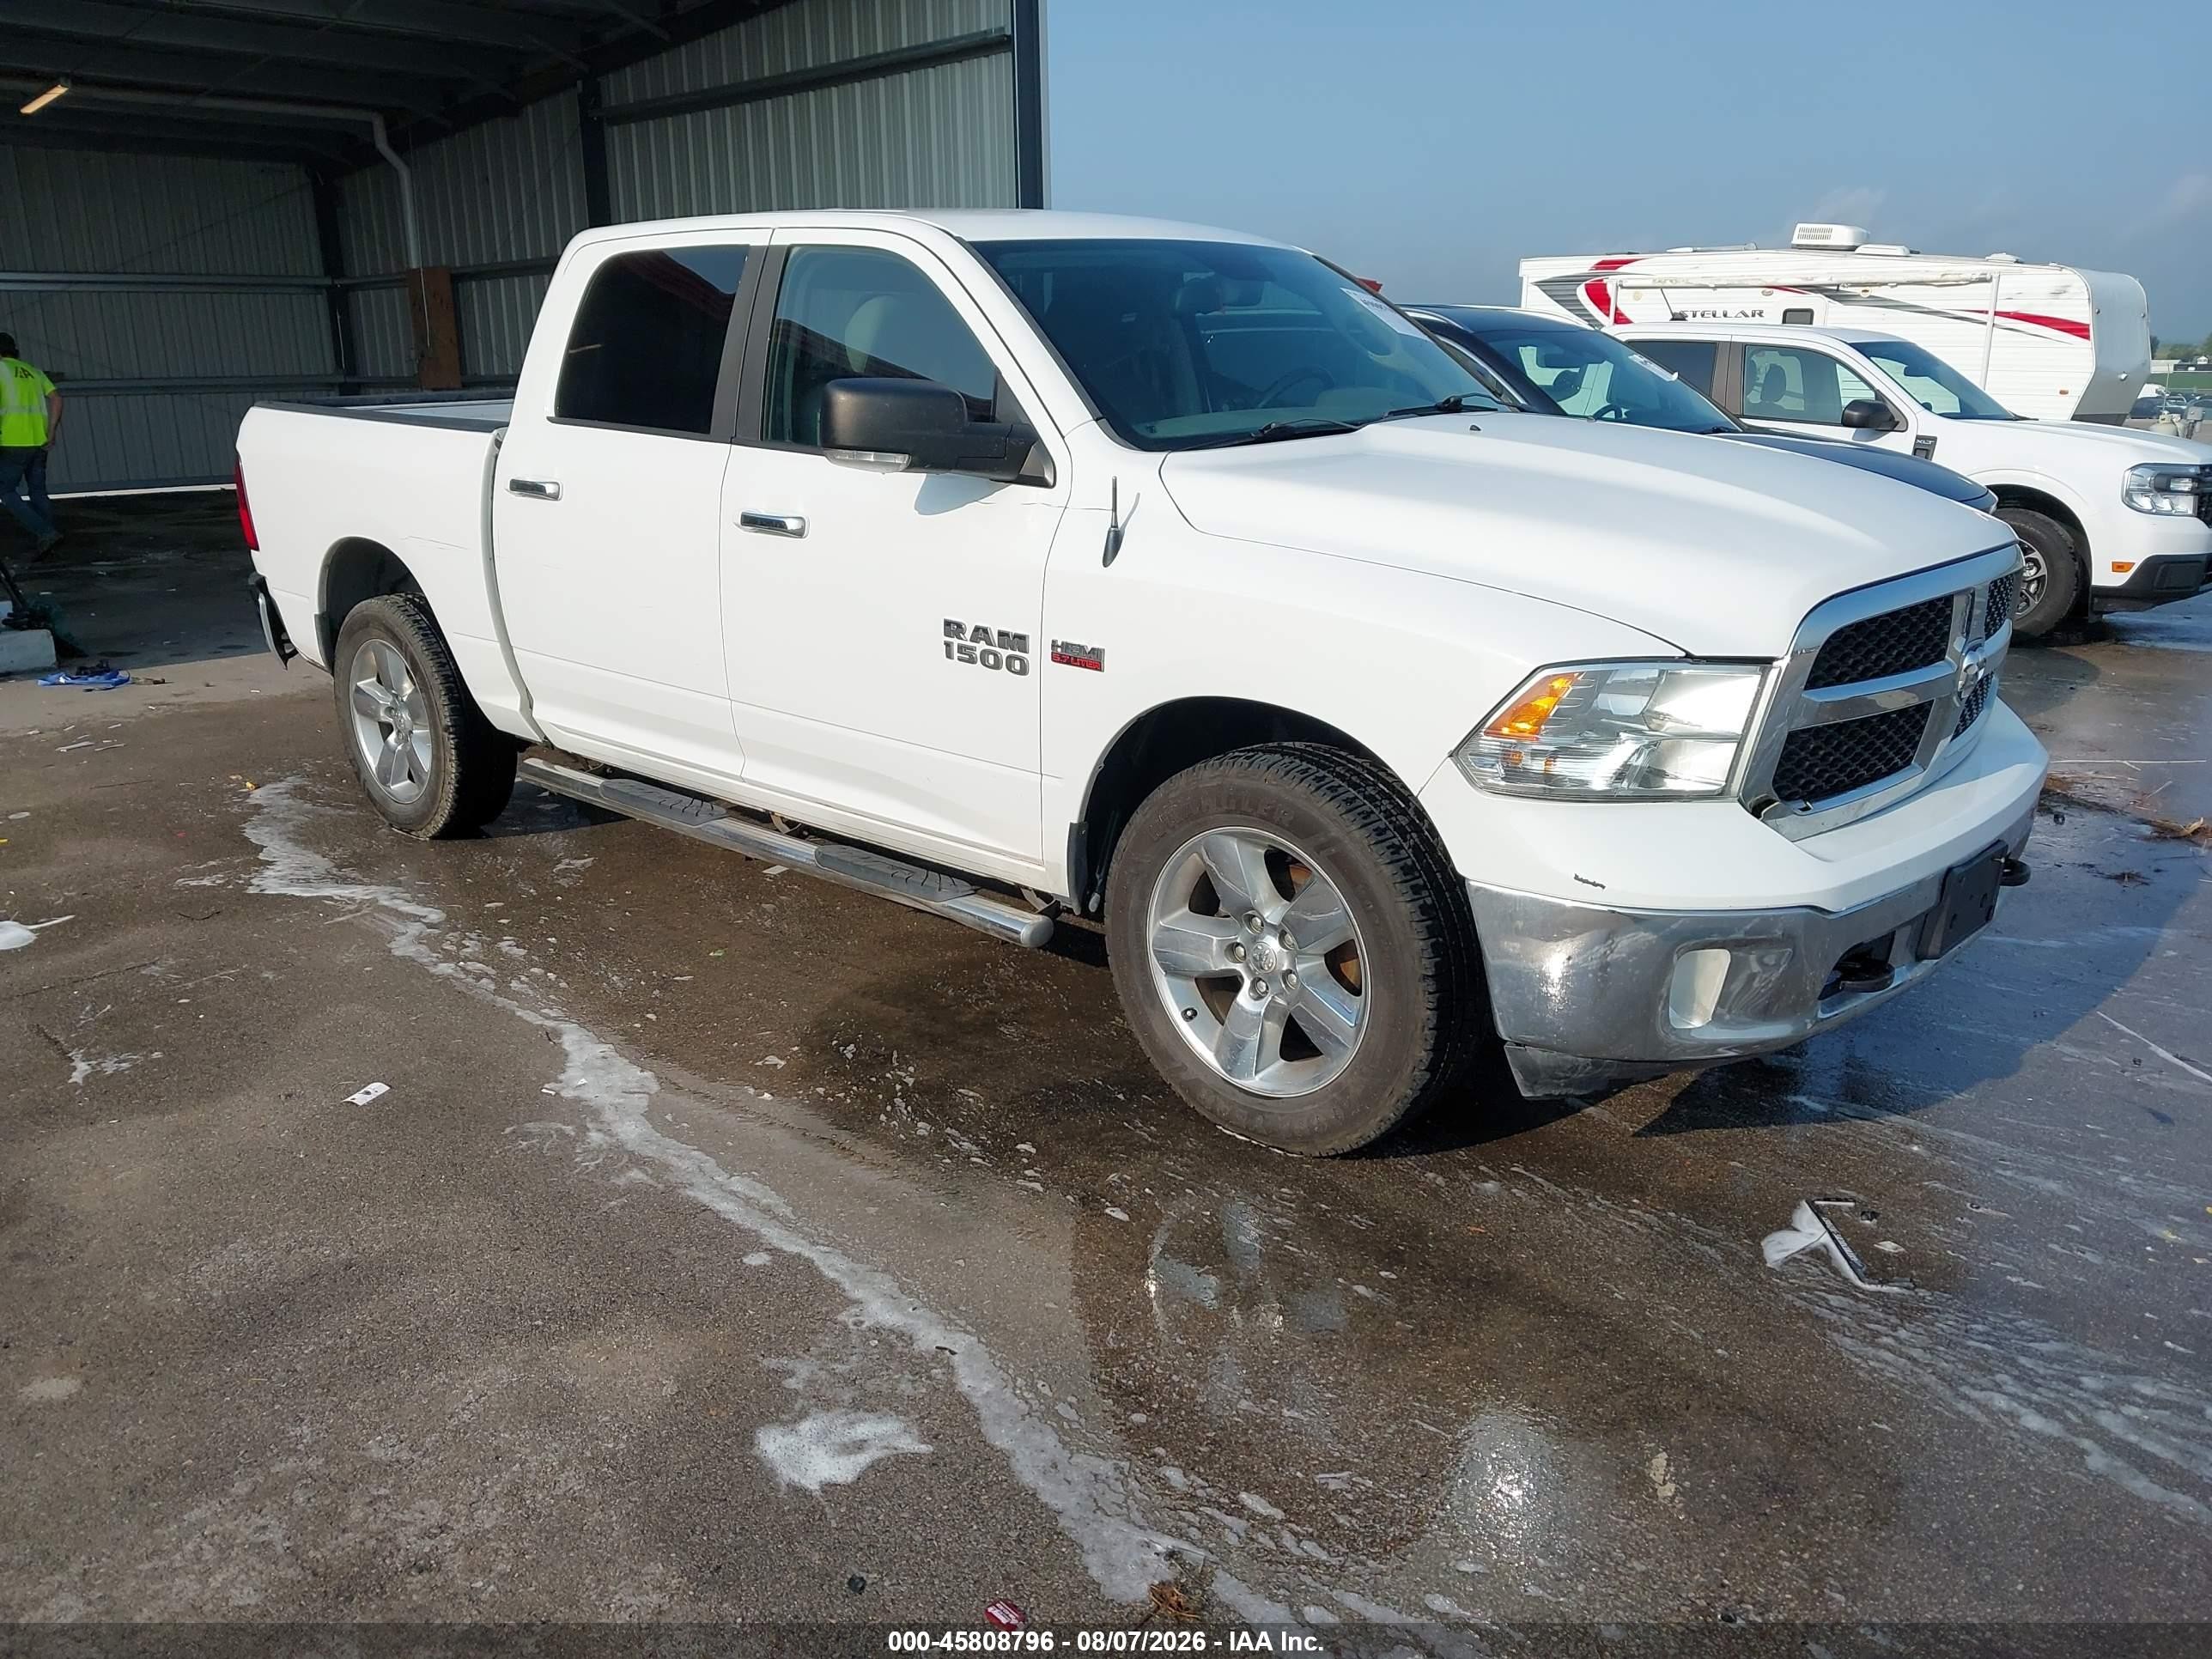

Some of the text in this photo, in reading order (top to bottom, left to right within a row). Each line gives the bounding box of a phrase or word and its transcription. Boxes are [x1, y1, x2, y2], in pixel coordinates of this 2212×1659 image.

[1679, 310, 1765, 319] STELLAR
[944, 618, 1030, 653] RAM
[944, 641, 1030, 677] 1500
[1051, 639, 1105, 661] HEMI
[1053, 653, 1102, 670] 5.7 LITER
